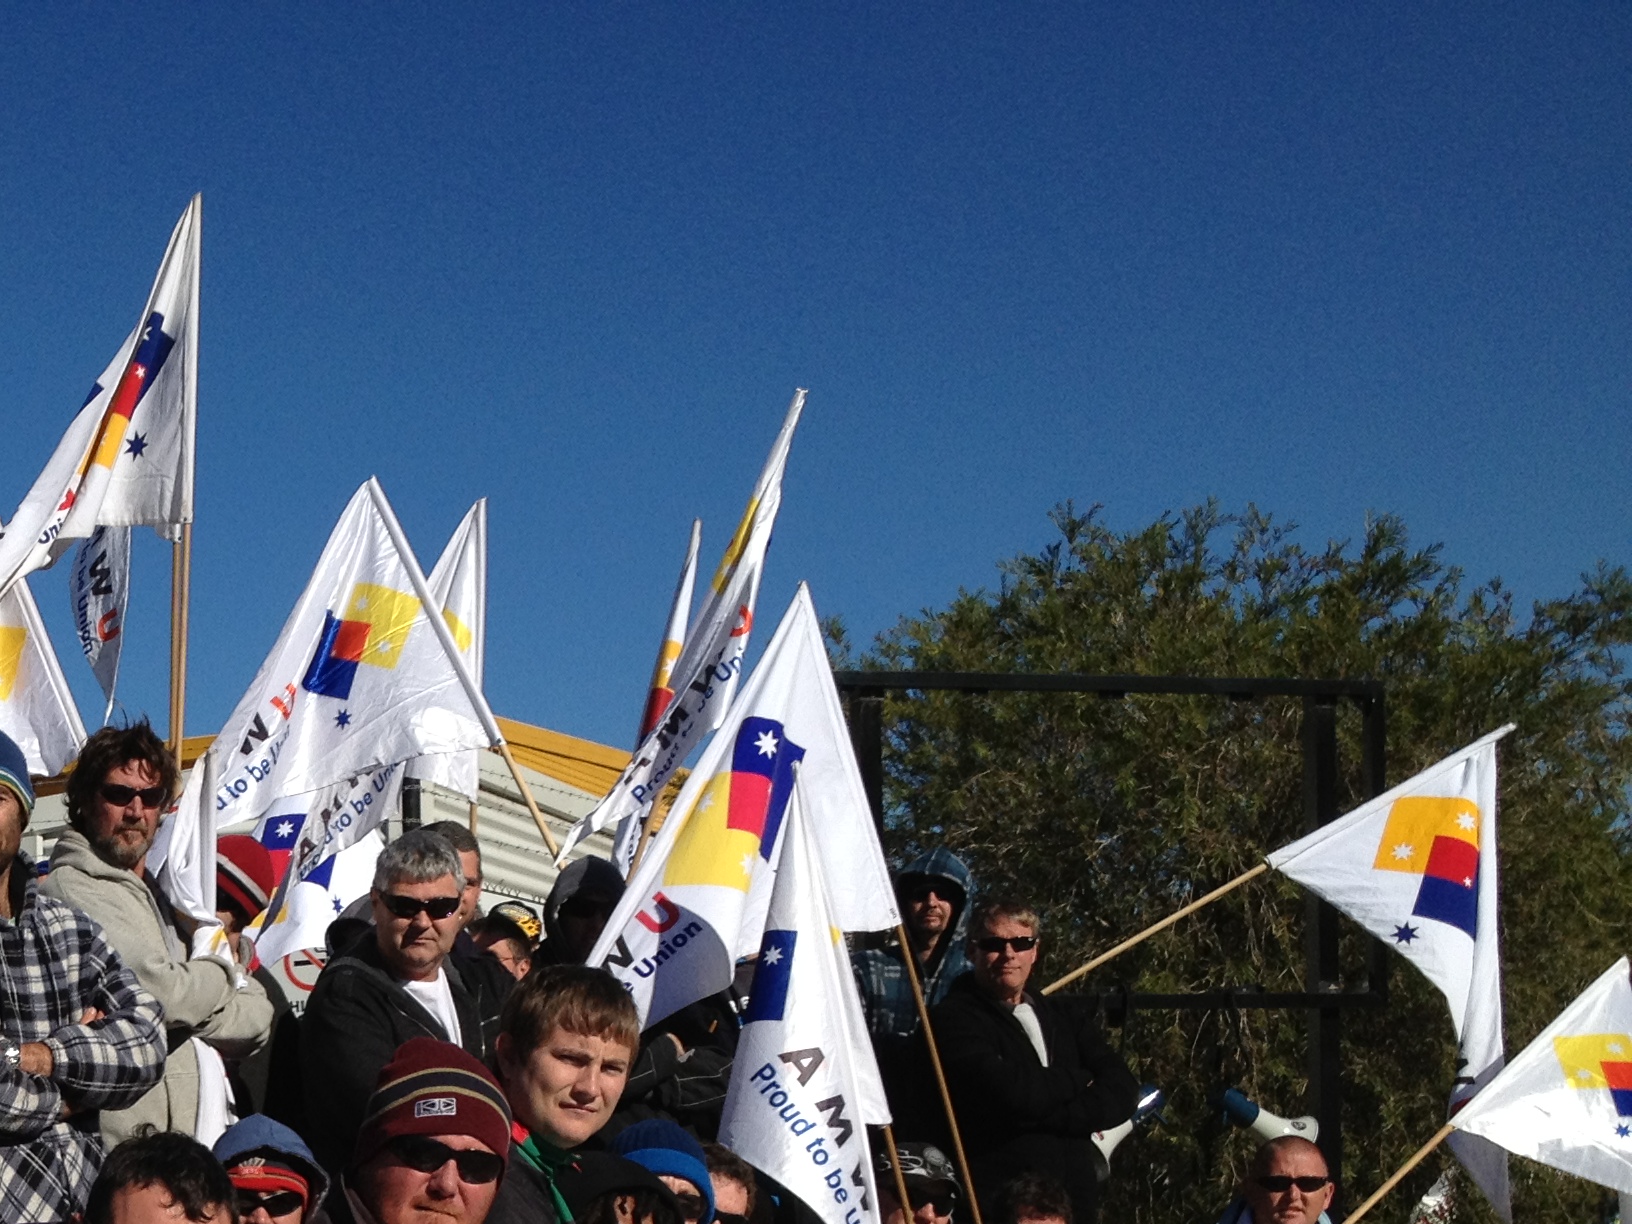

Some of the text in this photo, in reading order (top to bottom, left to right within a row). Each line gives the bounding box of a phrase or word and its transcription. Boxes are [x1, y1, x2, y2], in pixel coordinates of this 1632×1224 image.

[224, 778, 248, 799] to
[245, 758, 271, 783] be
[349, 792, 373, 815] be
[632, 921, 703, 978] Union
[750, 1062, 817, 1137] Proud
[805, 1137, 829, 1166] to
[824, 1168, 848, 1205] be
